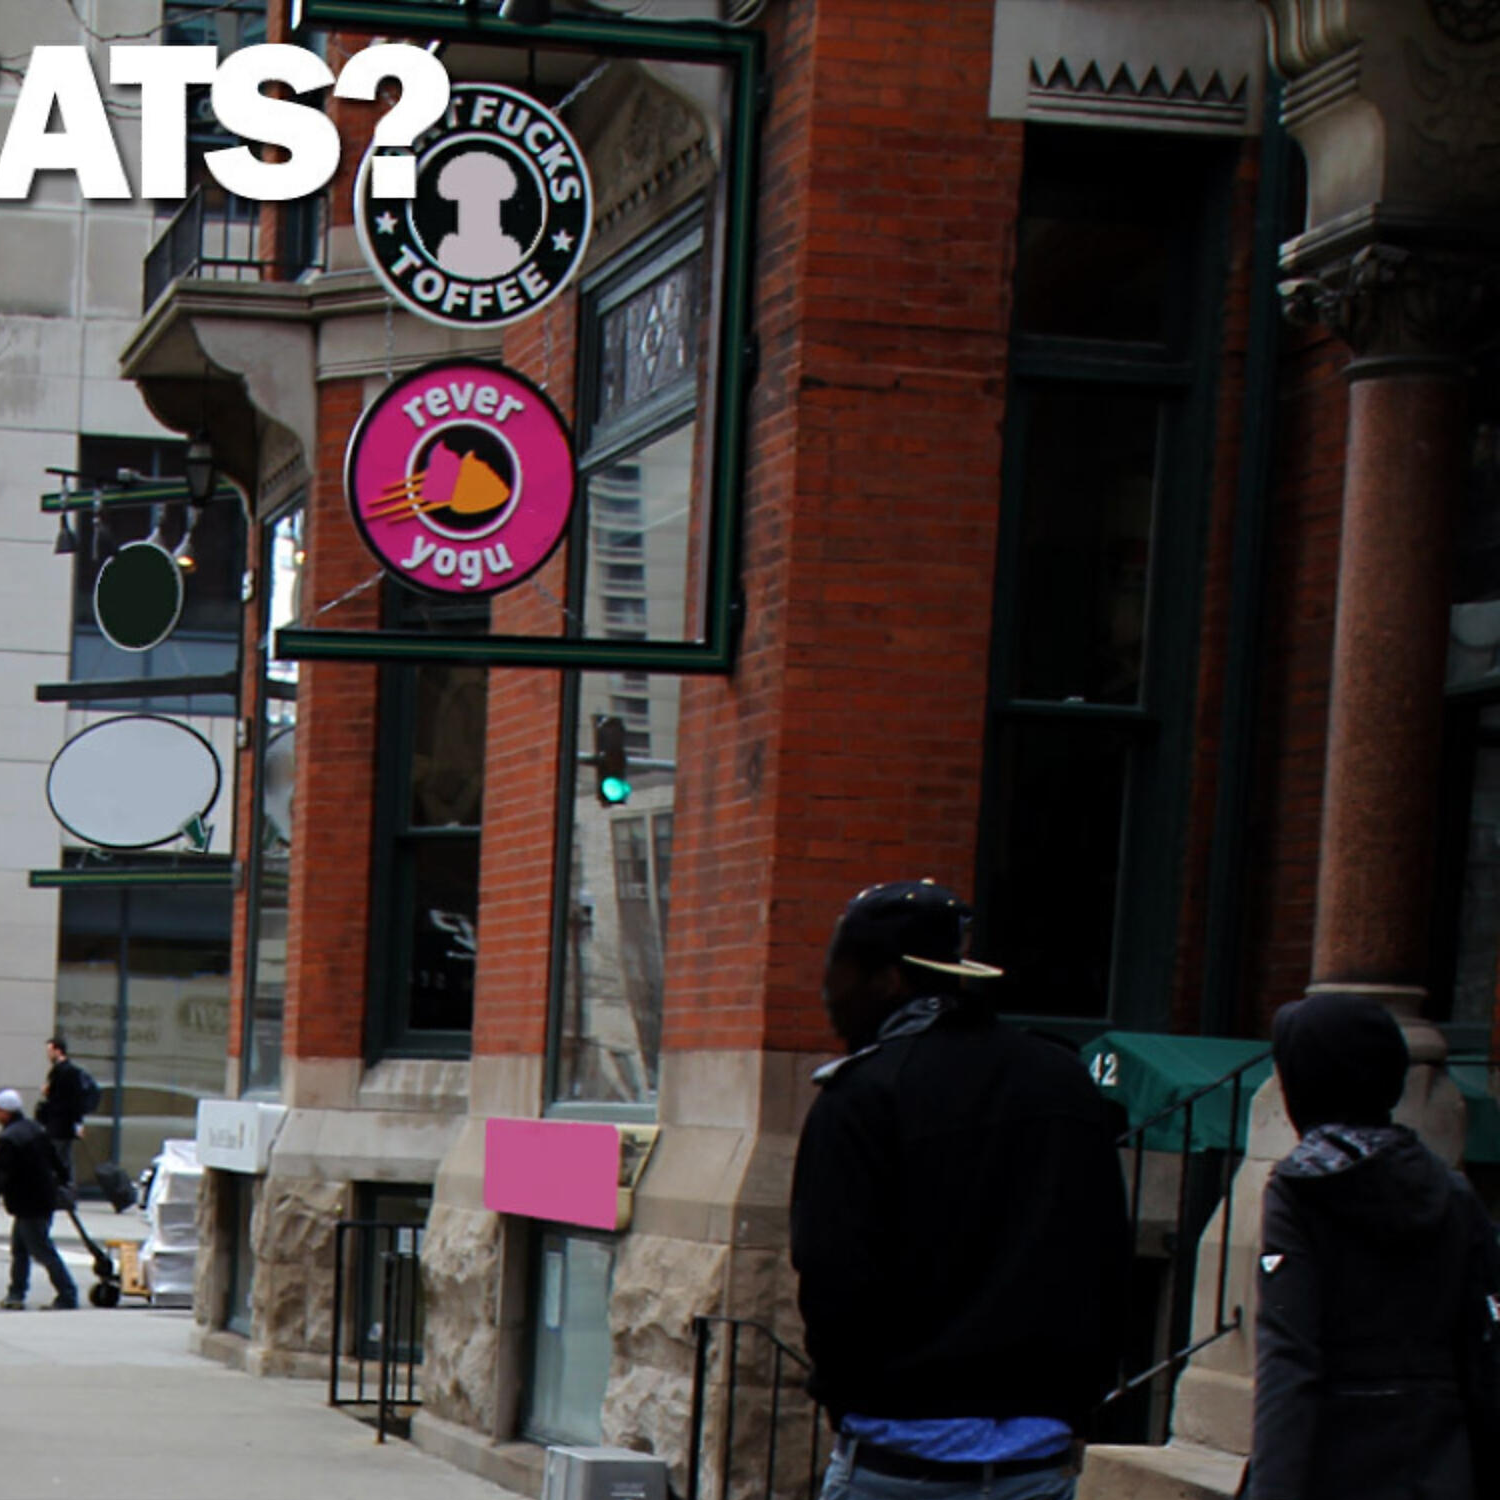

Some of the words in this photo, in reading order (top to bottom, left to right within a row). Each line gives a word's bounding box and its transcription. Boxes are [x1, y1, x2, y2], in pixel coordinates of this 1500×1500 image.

[390, 243, 550, 317] TOFFEE
[402, 381, 525, 428] rever
[400, 535, 514, 588] yogu
